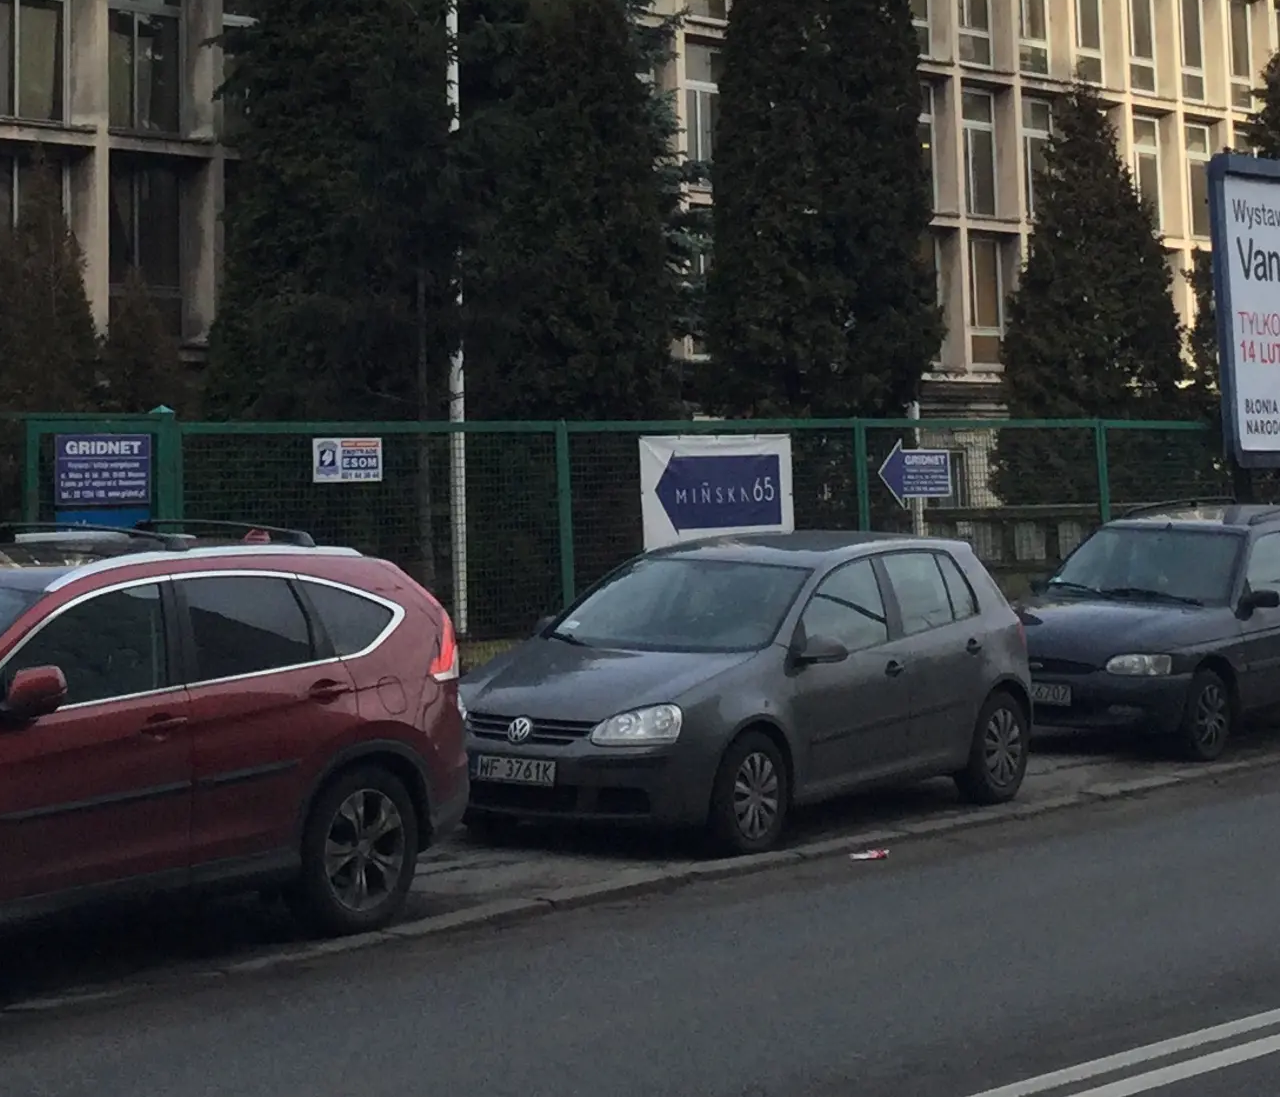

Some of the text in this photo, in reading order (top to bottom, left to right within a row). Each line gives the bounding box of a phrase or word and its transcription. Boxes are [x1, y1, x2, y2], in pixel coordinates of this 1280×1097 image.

[1236, 236, 1280, 283] Van
[1238, 311, 1280, 337] TYLKO
[1240, 340, 1256, 363] 14
[1245, 398, 1278, 414] BŁONIA
[65, 440, 142, 455] GRIDNET
[342, 457, 377, 468] ESOM
[904, 454, 946, 466] GRIDNET
[753, 477, 775, 502] 65
[505, 759, 553, 782] 3761K
